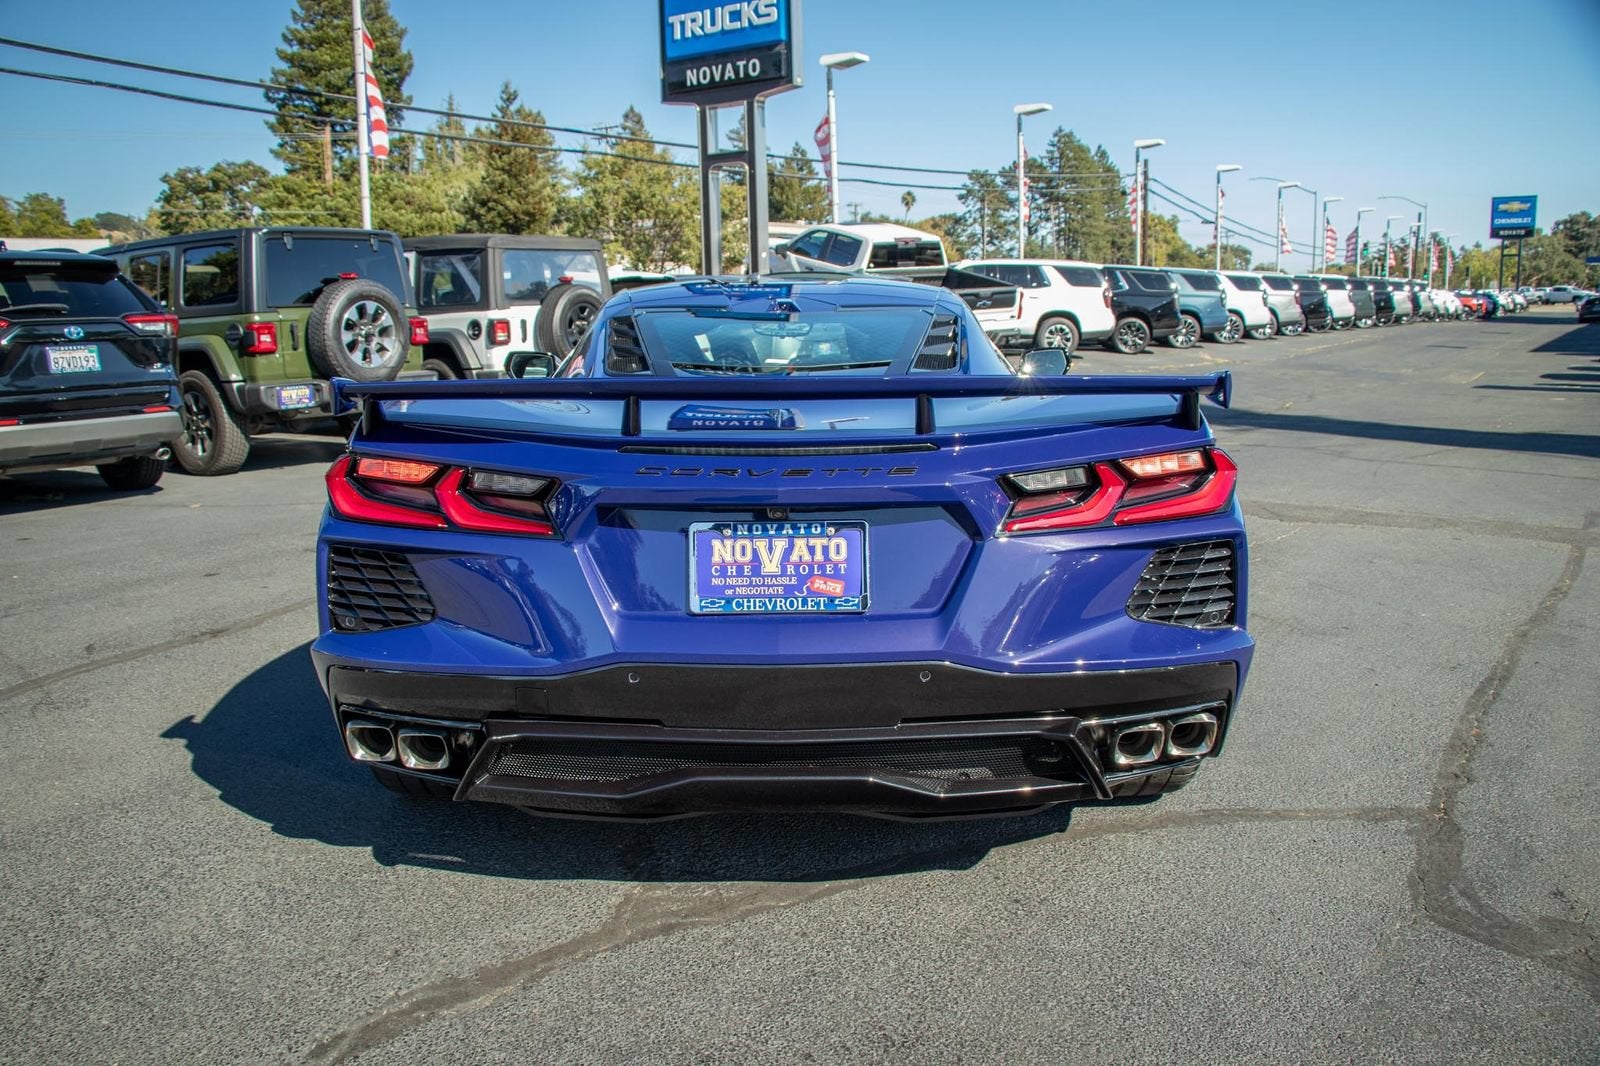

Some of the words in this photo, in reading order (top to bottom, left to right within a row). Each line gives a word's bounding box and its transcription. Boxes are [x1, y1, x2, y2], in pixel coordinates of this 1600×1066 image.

[668, 0, 778, 40] TRUCKS
[686, 58, 761, 87] NOVATO
[635, 466, 918, 478] CORVETTE
[736, 523, 822, 535] NOVATO
[711, 537, 848, 575] NOVATO
[711, 577, 725, 586] NO
[726, 577, 750, 586] NEED
[751, 577, 763, 585] TO
[764, 576, 798, 585] HASSLE
[735, 586, 784, 595] NEGOTIATE
[814, 583, 842, 594] PRICE
[732, 597, 828, 611] CHEVROLET
